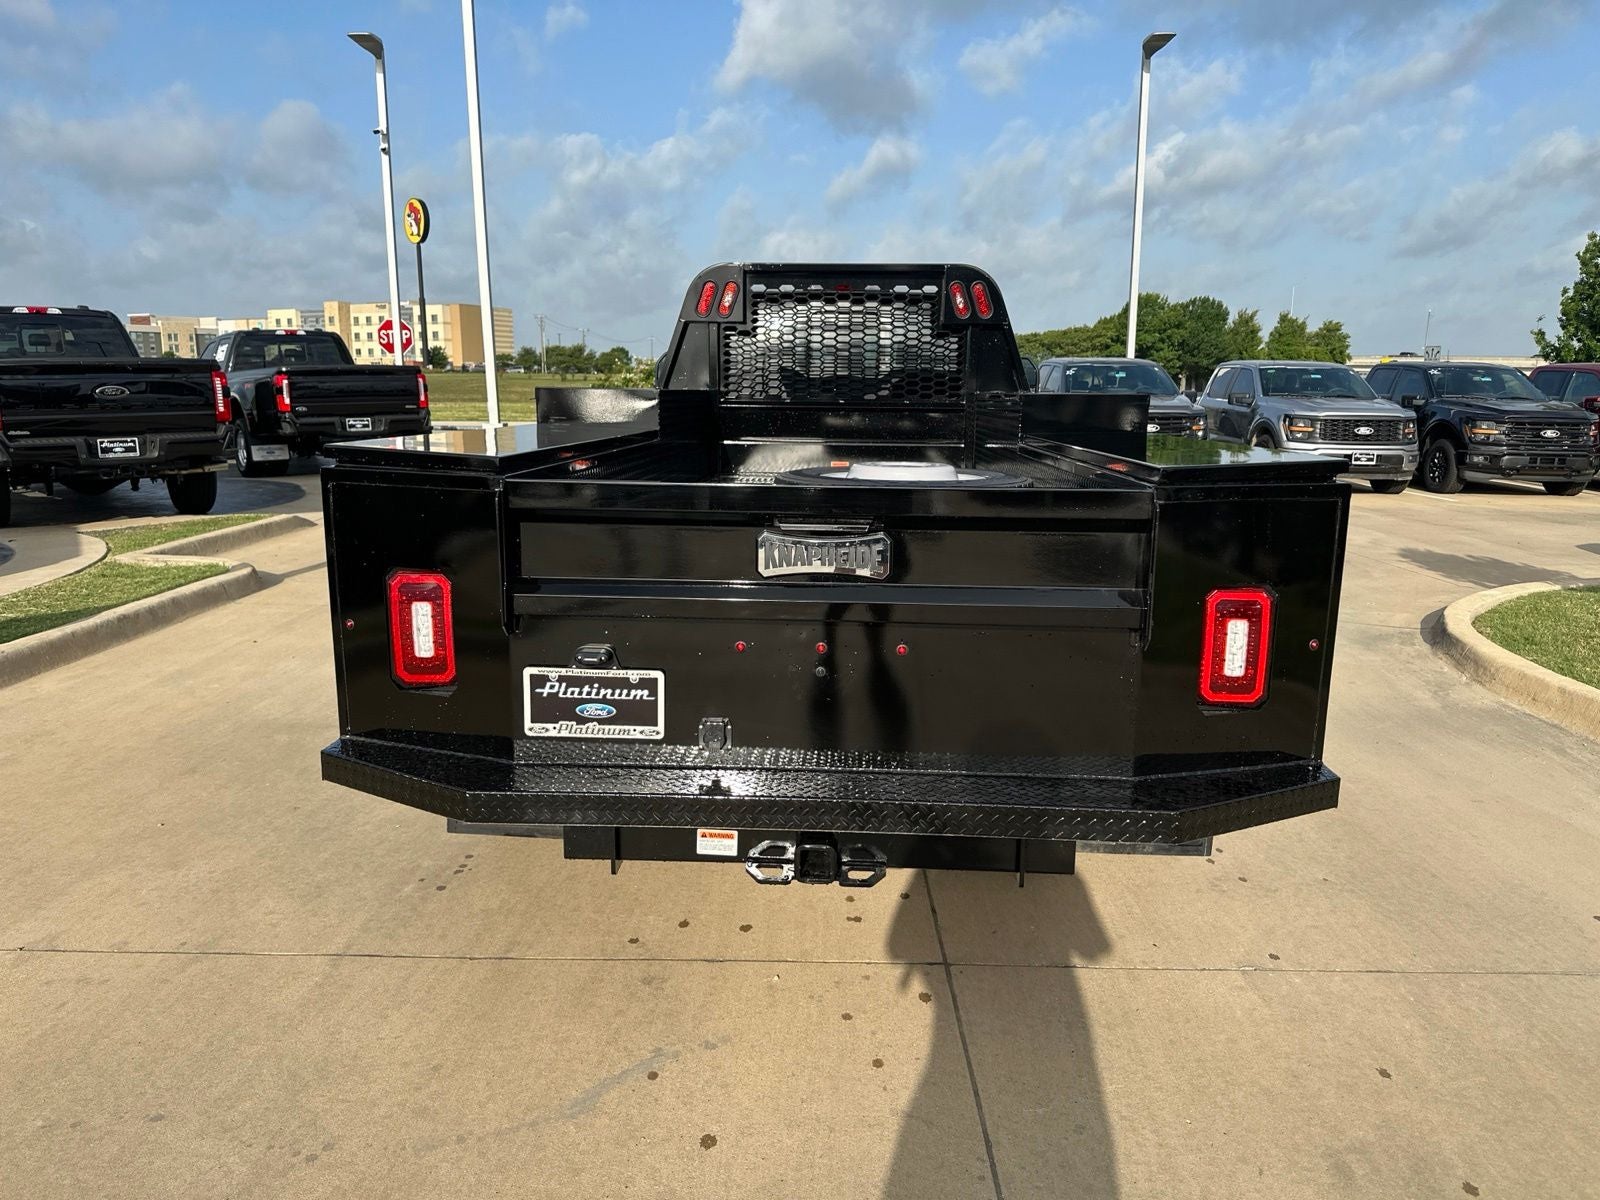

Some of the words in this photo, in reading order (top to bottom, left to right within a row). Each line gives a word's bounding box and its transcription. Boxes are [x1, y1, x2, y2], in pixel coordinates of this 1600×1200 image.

[379, 329, 411, 344] STP
[764, 540, 884, 571] KNAPHEIDE
[535, 681, 656, 701] Platinum
[583, 704, 609, 716] Ford
[557, 721, 637, 737] Platinum
[708, 832, 735, 840] WARNING
